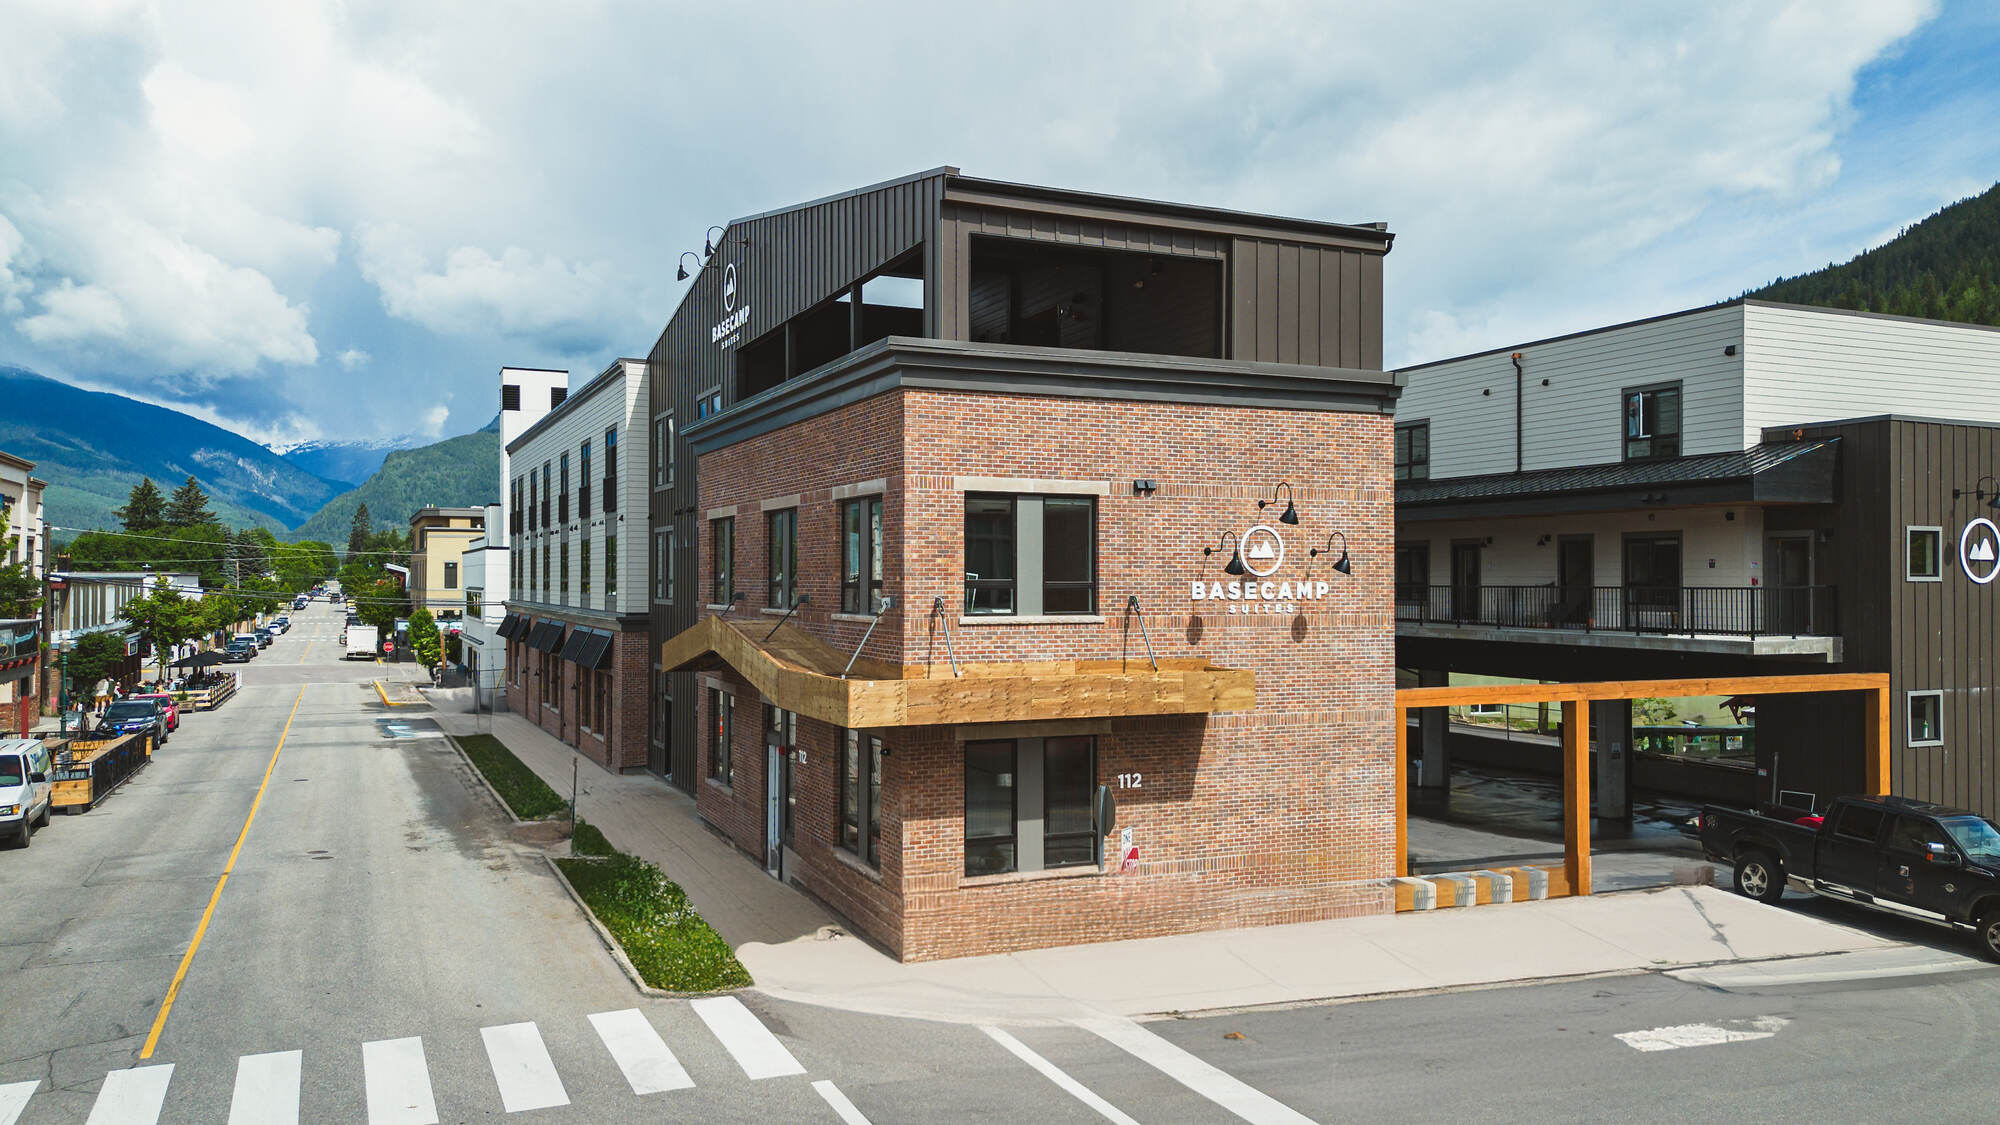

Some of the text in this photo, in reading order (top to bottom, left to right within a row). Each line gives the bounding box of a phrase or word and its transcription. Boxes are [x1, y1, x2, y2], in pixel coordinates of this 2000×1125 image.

[711, 305, 750, 343] BASECAMP
[721, 333, 740, 350] SUITES
[1191, 581, 1330, 601] BASECAMP
[1228, 603, 1295, 614] SUITES
[798, 750, 808, 764] 112
[1117, 772, 1143, 789] 112
